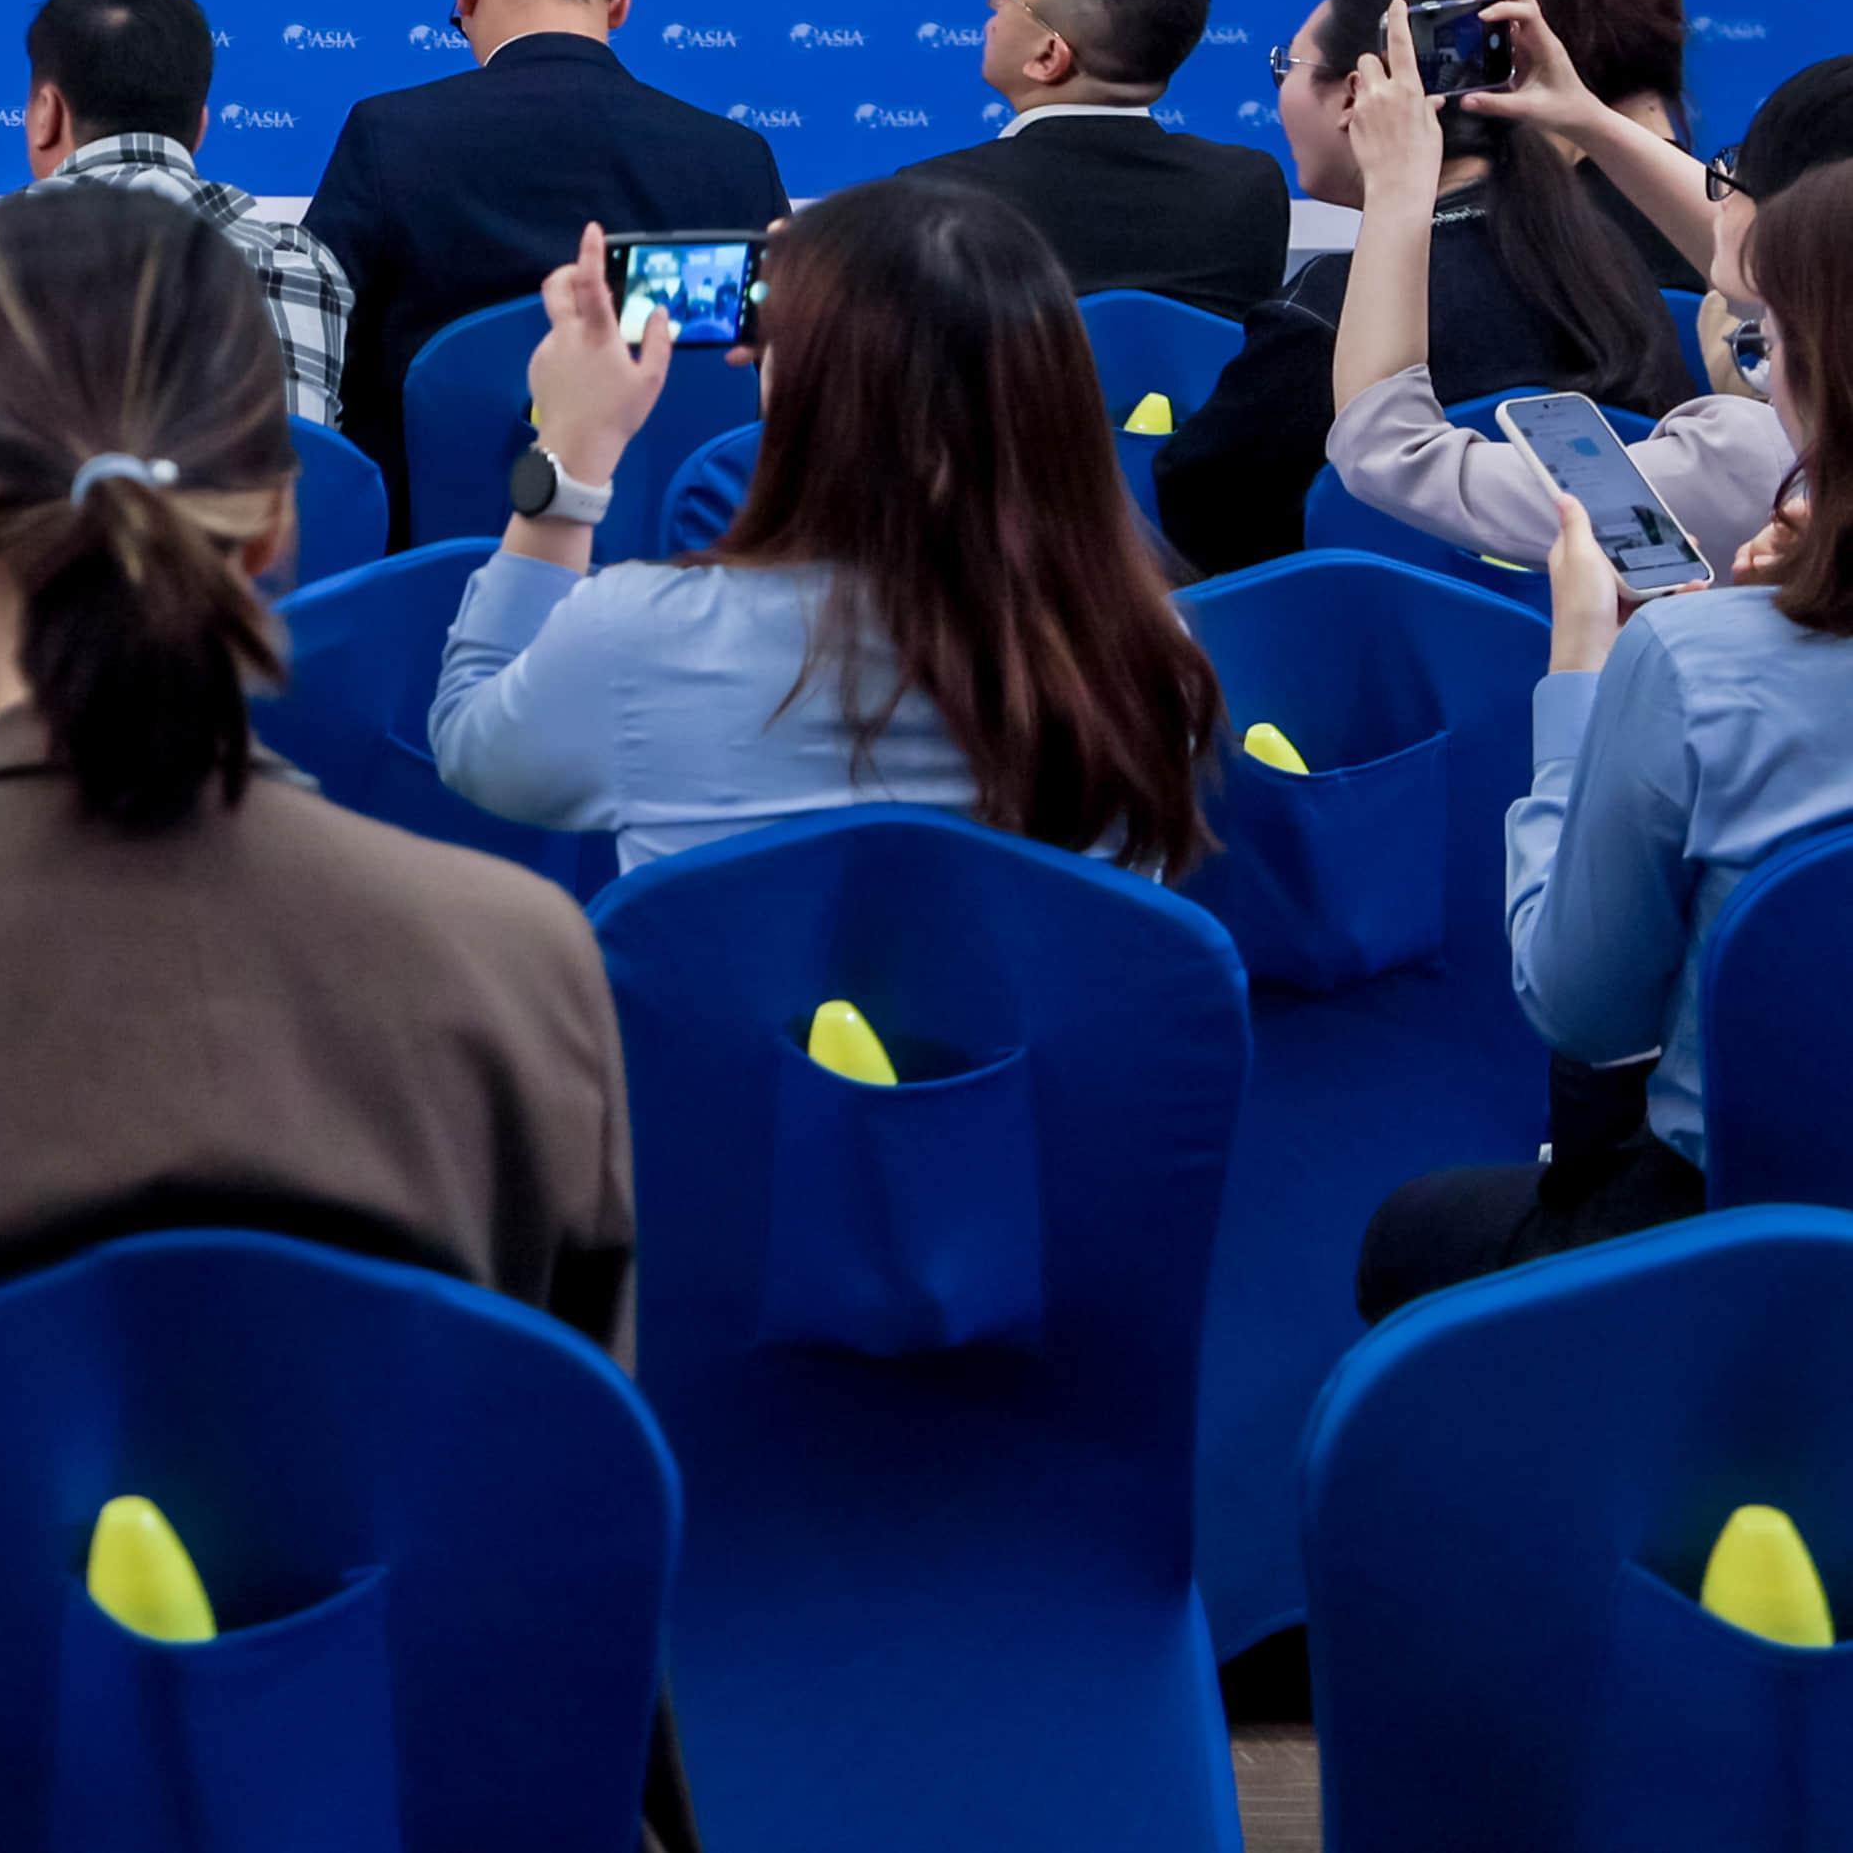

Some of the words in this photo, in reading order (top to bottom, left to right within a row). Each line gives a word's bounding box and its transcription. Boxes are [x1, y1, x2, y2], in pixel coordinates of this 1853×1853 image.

[310, 31, 356, 49] ASIA
[690, 30, 736, 48] ASIA
[248, 111, 294, 129] ASIA
